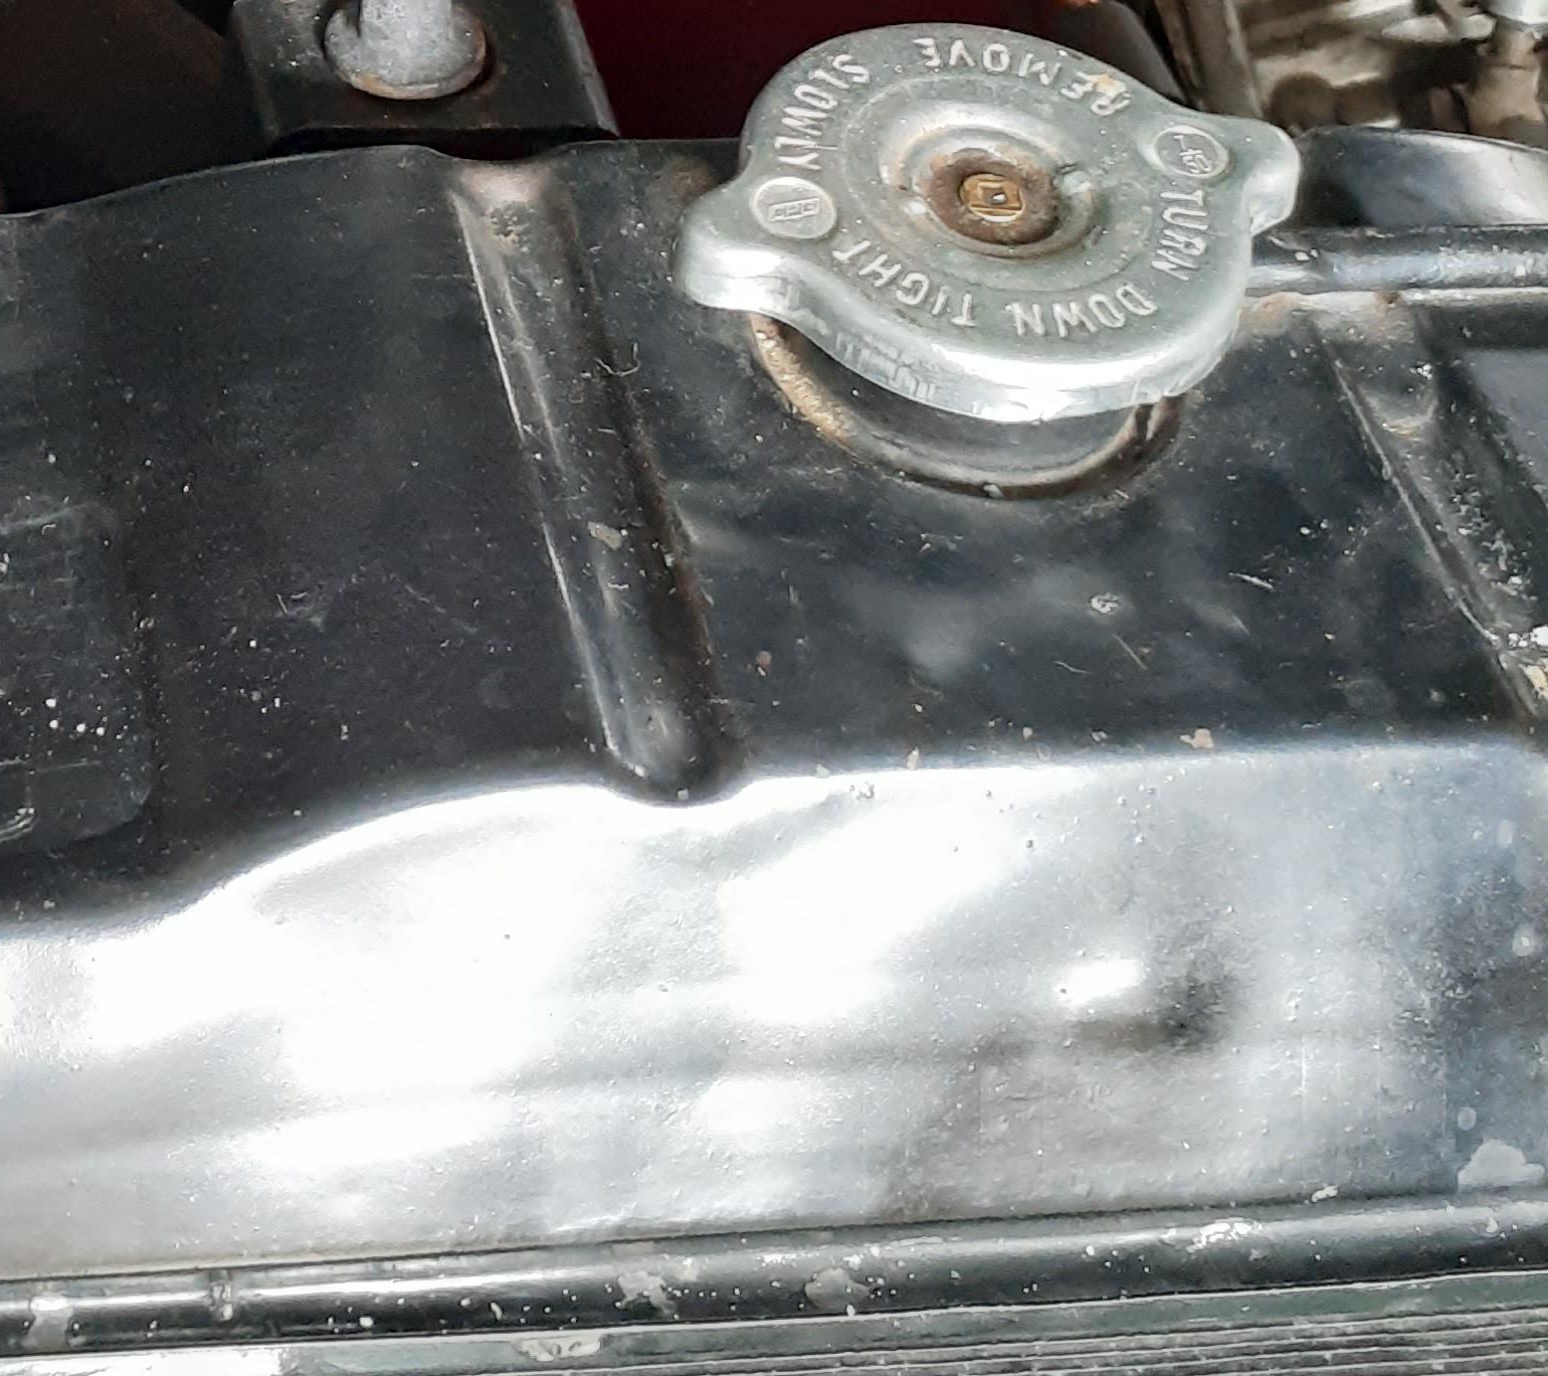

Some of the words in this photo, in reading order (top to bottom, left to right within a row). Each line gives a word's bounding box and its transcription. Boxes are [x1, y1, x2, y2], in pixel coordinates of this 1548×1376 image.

[772, 52, 872, 173] SLOWLY
[911, 35, 1133, 117] REMOVE
[1150, 188, 1211, 282] TURN
[830, 239, 976, 330] TIGHT
[1011, 280, 1159, 339] DOWN
